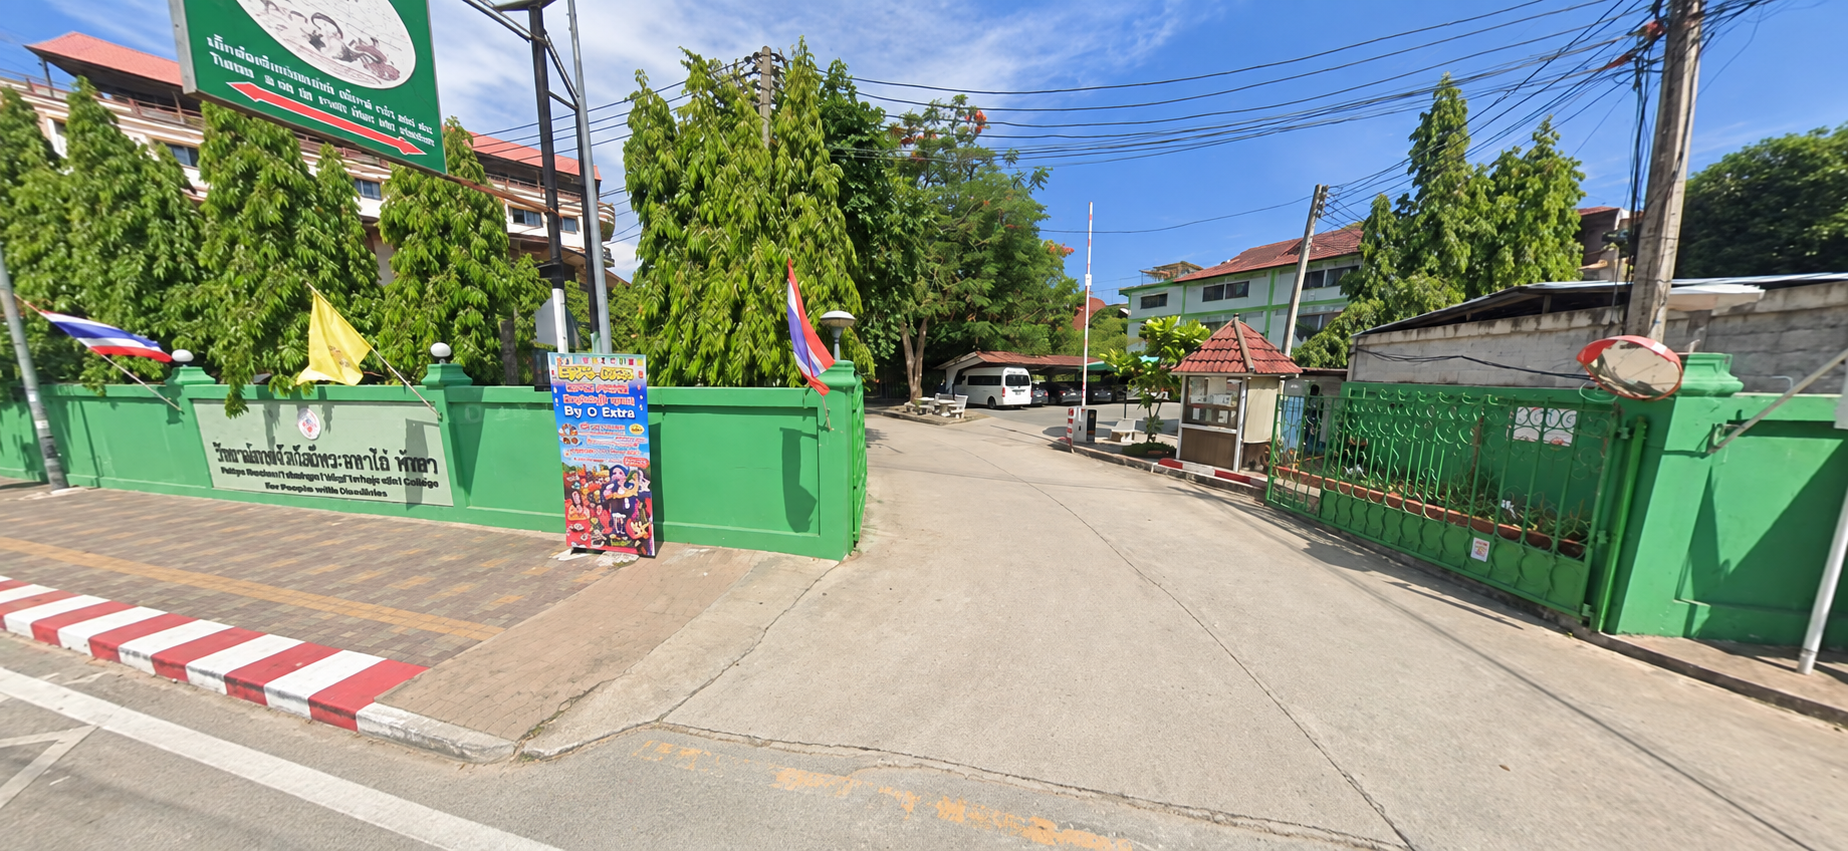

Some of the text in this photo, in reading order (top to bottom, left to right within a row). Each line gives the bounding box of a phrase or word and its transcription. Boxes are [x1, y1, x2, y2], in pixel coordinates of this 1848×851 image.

[564, 405, 635, 418] By O Extra
